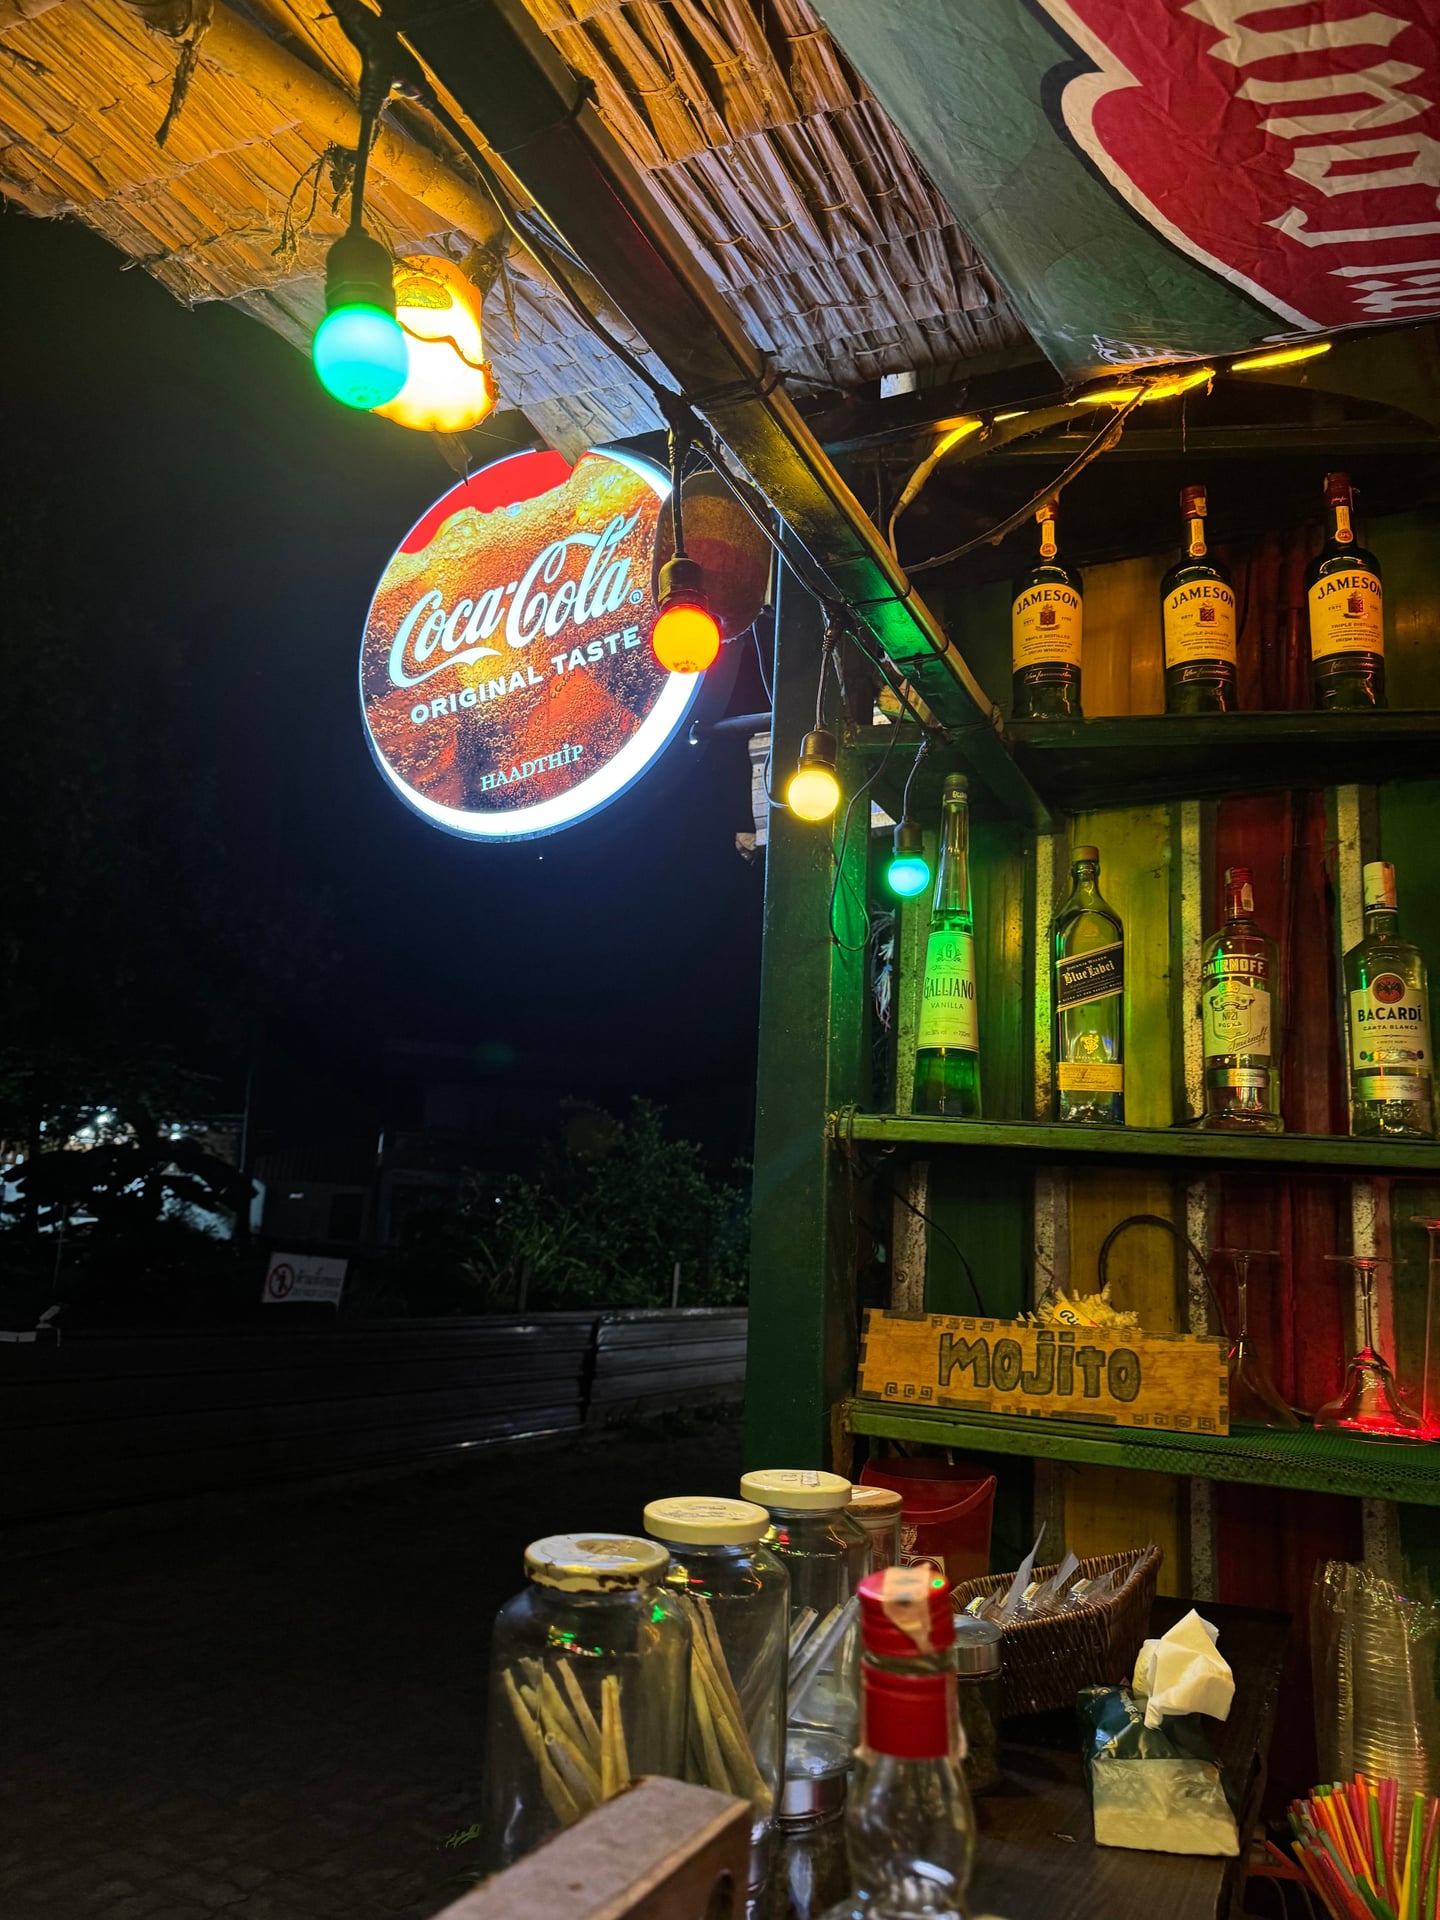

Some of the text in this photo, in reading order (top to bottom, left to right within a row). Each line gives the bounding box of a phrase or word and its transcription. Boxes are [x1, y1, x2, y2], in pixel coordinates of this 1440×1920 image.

[389, 507, 642, 687] Coca-Cola
[1172, 586, 1234, 609] JAMESON
[1318, 576, 1382, 600] JAMESON
[1016, 589, 1079, 615] JAMESON
[410, 626, 641, 724] ORIGINAL TASTE
[1062, 970, 1088, 986] Blue
[1086, 960, 1115, 978] Label
[1202, 958, 1265, 978] SMIRNOFF
[923, 976, 974, 1000] GALLIANO
